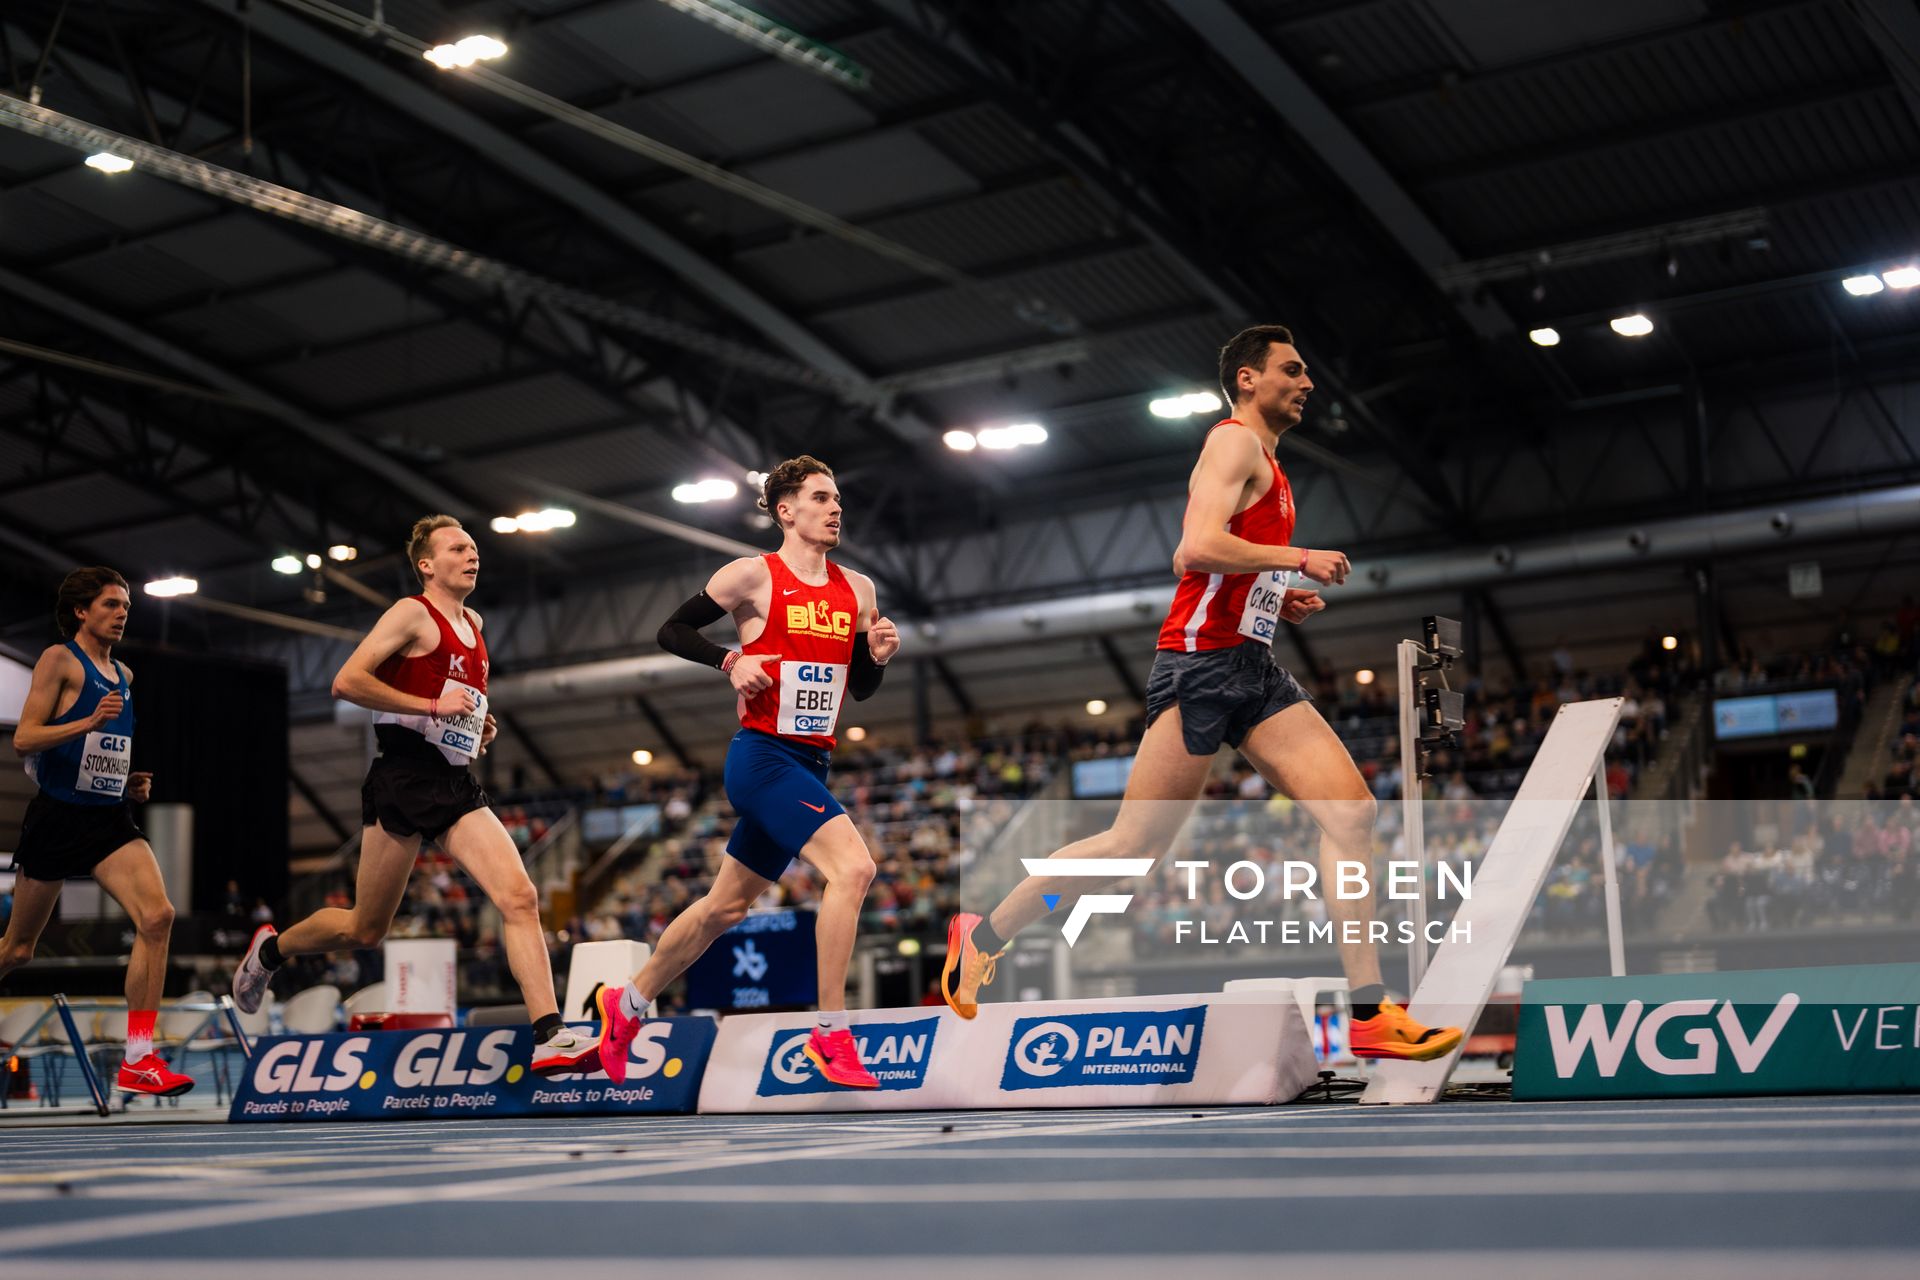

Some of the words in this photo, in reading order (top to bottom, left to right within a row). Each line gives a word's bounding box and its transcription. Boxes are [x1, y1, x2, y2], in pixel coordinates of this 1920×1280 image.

[1250, 587, 1280, 616] C.KES
[786, 601, 851, 636] BLC
[448, 671, 468, 680] KIEFER
[796, 689, 834, 711] EBEL
[457, 736, 473, 747] PLAN
[1544, 992, 1800, 1079] WGV
[1832, 1006, 1920, 1051] VE
[852, 1034, 928, 1065] LAN
[1084, 1024, 1195, 1058] PLAN
[1082, 1063, 1187, 1075] INTERNATIONAL
[244, 1098, 288, 1114] Parcels
[291, 1101, 304, 1113] to
[305, 1097, 350, 1115] People
[383, 1093, 430, 1110] Parcels
[433, 1095, 449, 1108] to
[450, 1091, 497, 1110] People
[531, 1088, 582, 1104] Parcels
[585, 1090, 601, 1102] to
[602, 1086, 654, 1105] People
